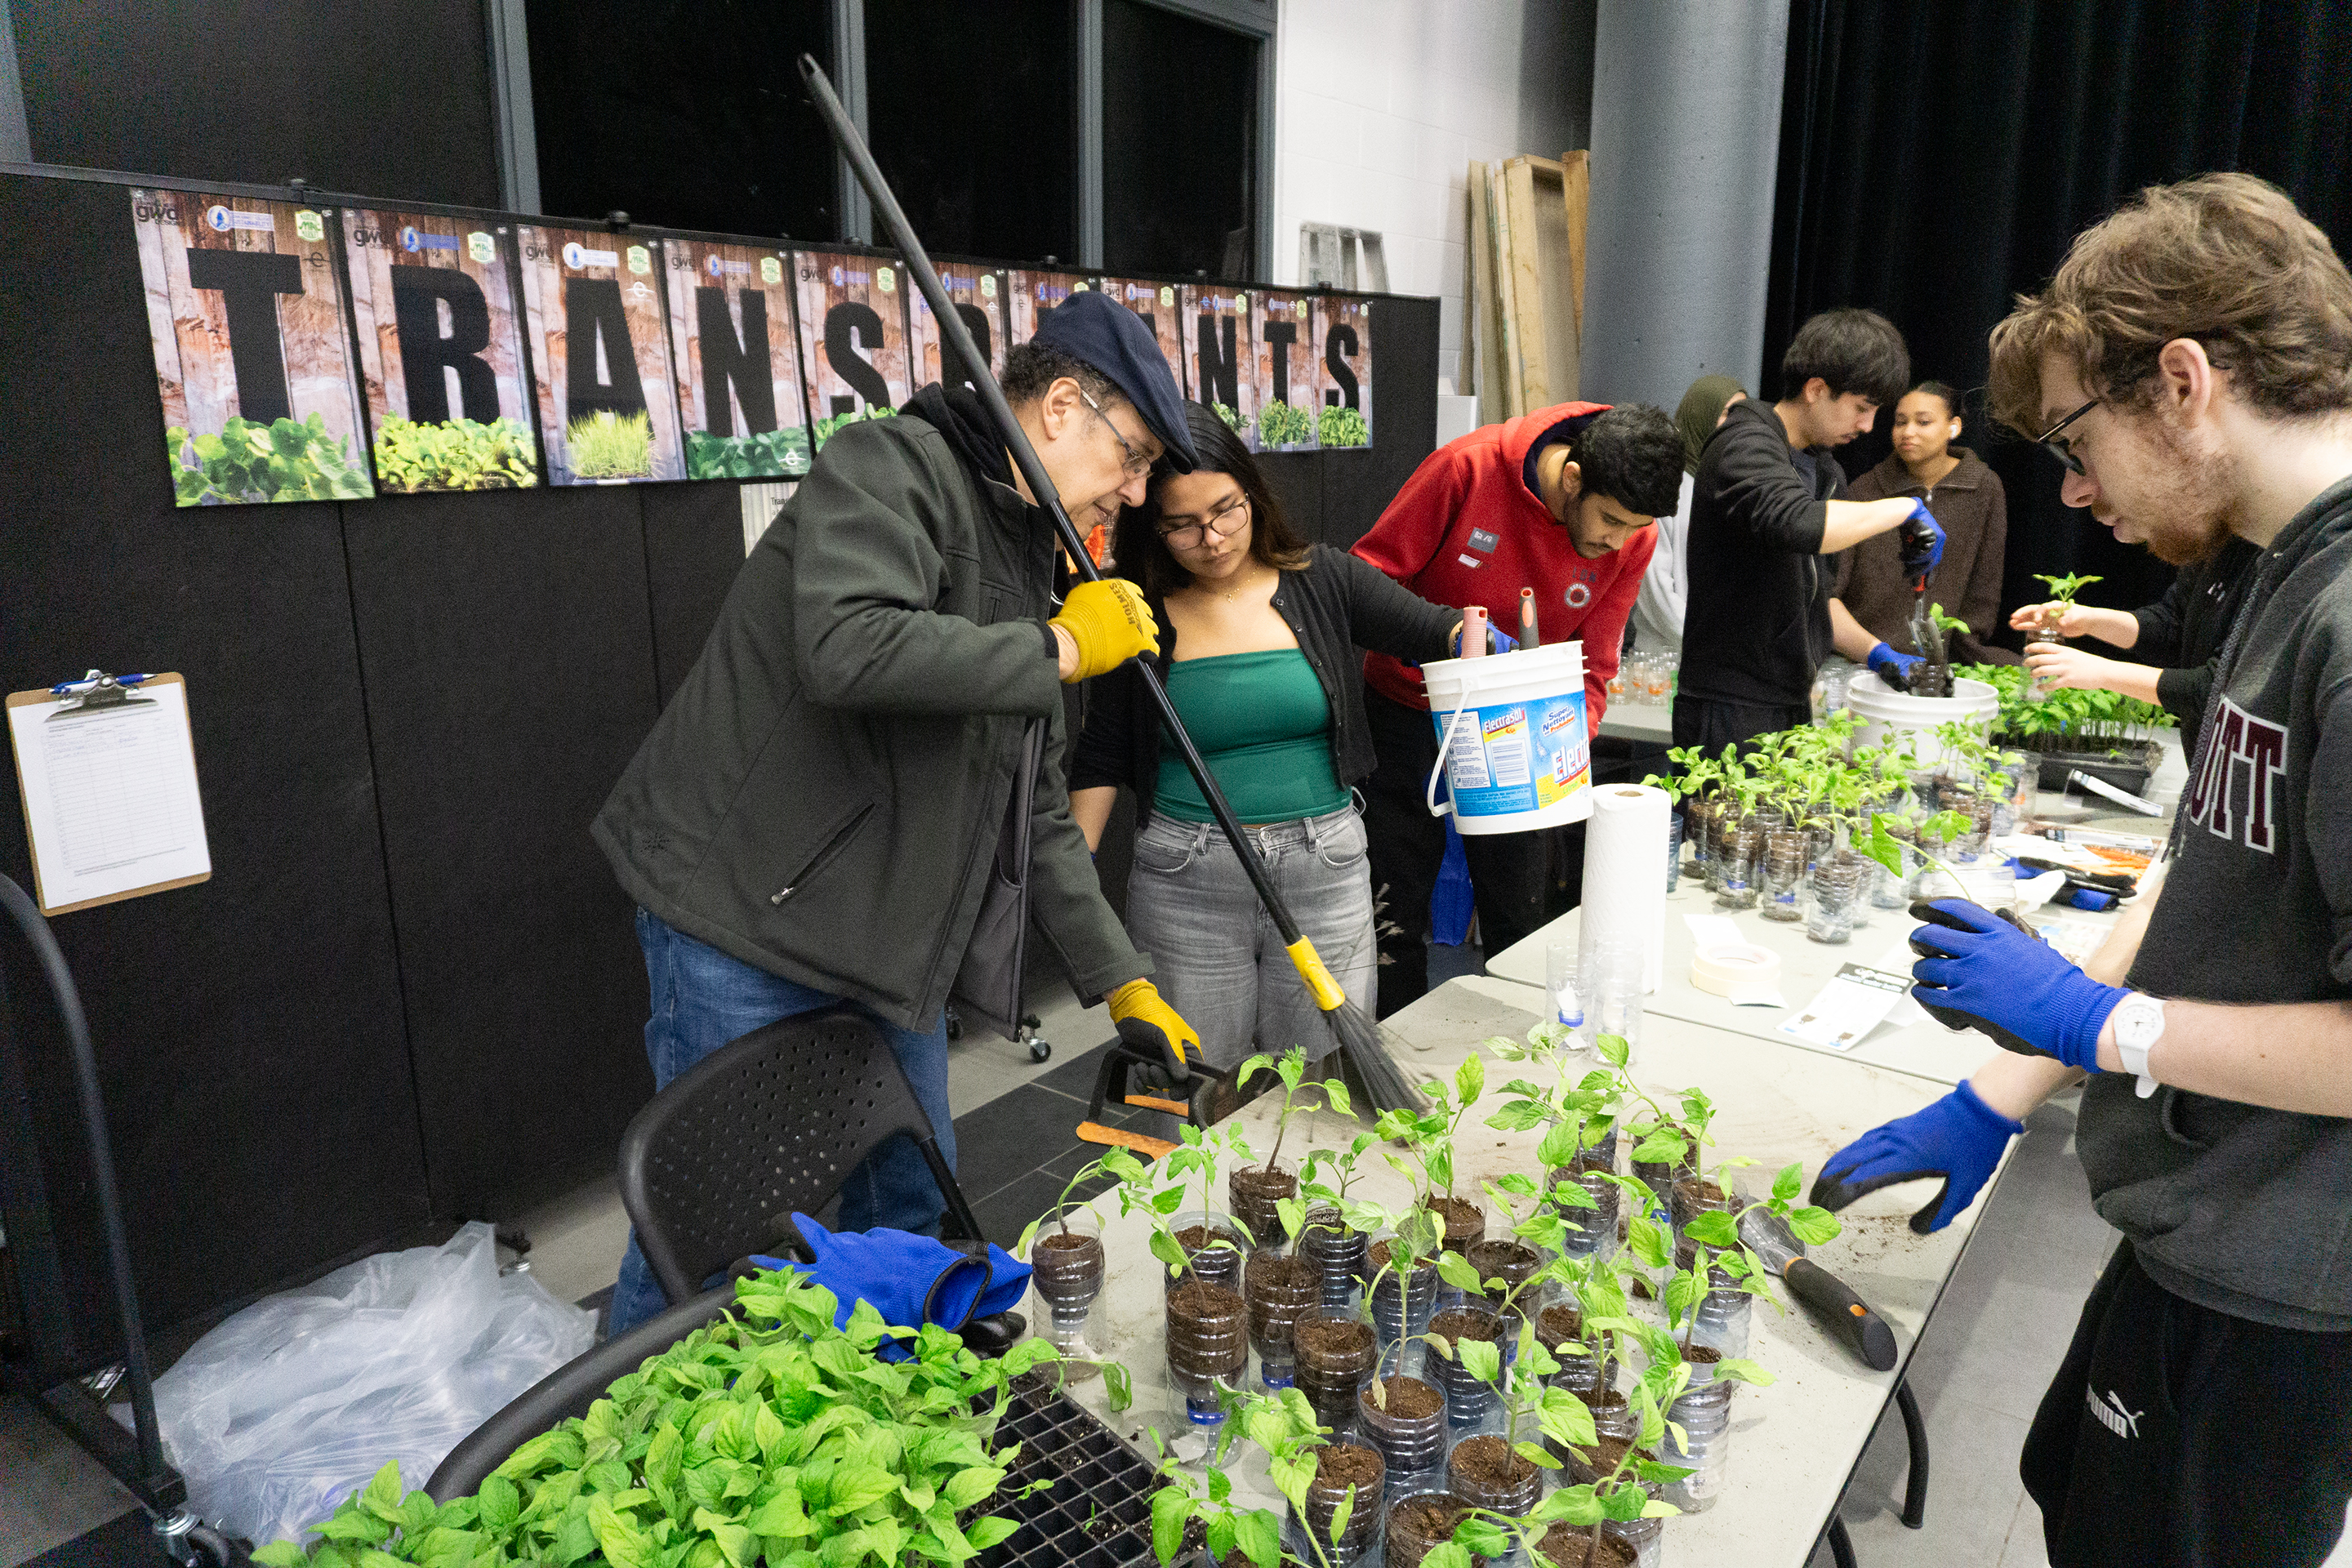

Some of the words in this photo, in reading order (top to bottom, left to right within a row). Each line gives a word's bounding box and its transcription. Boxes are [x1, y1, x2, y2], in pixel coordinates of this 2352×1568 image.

[187, 247, 1359, 438] TRANSPNTS
[1109, 582, 1135, 625] HOLMES
[1484, 707, 1523, 733] Electrasol
[1548, 706, 1568, 721] Super
[1839, 972, 1864, 983] plastic
